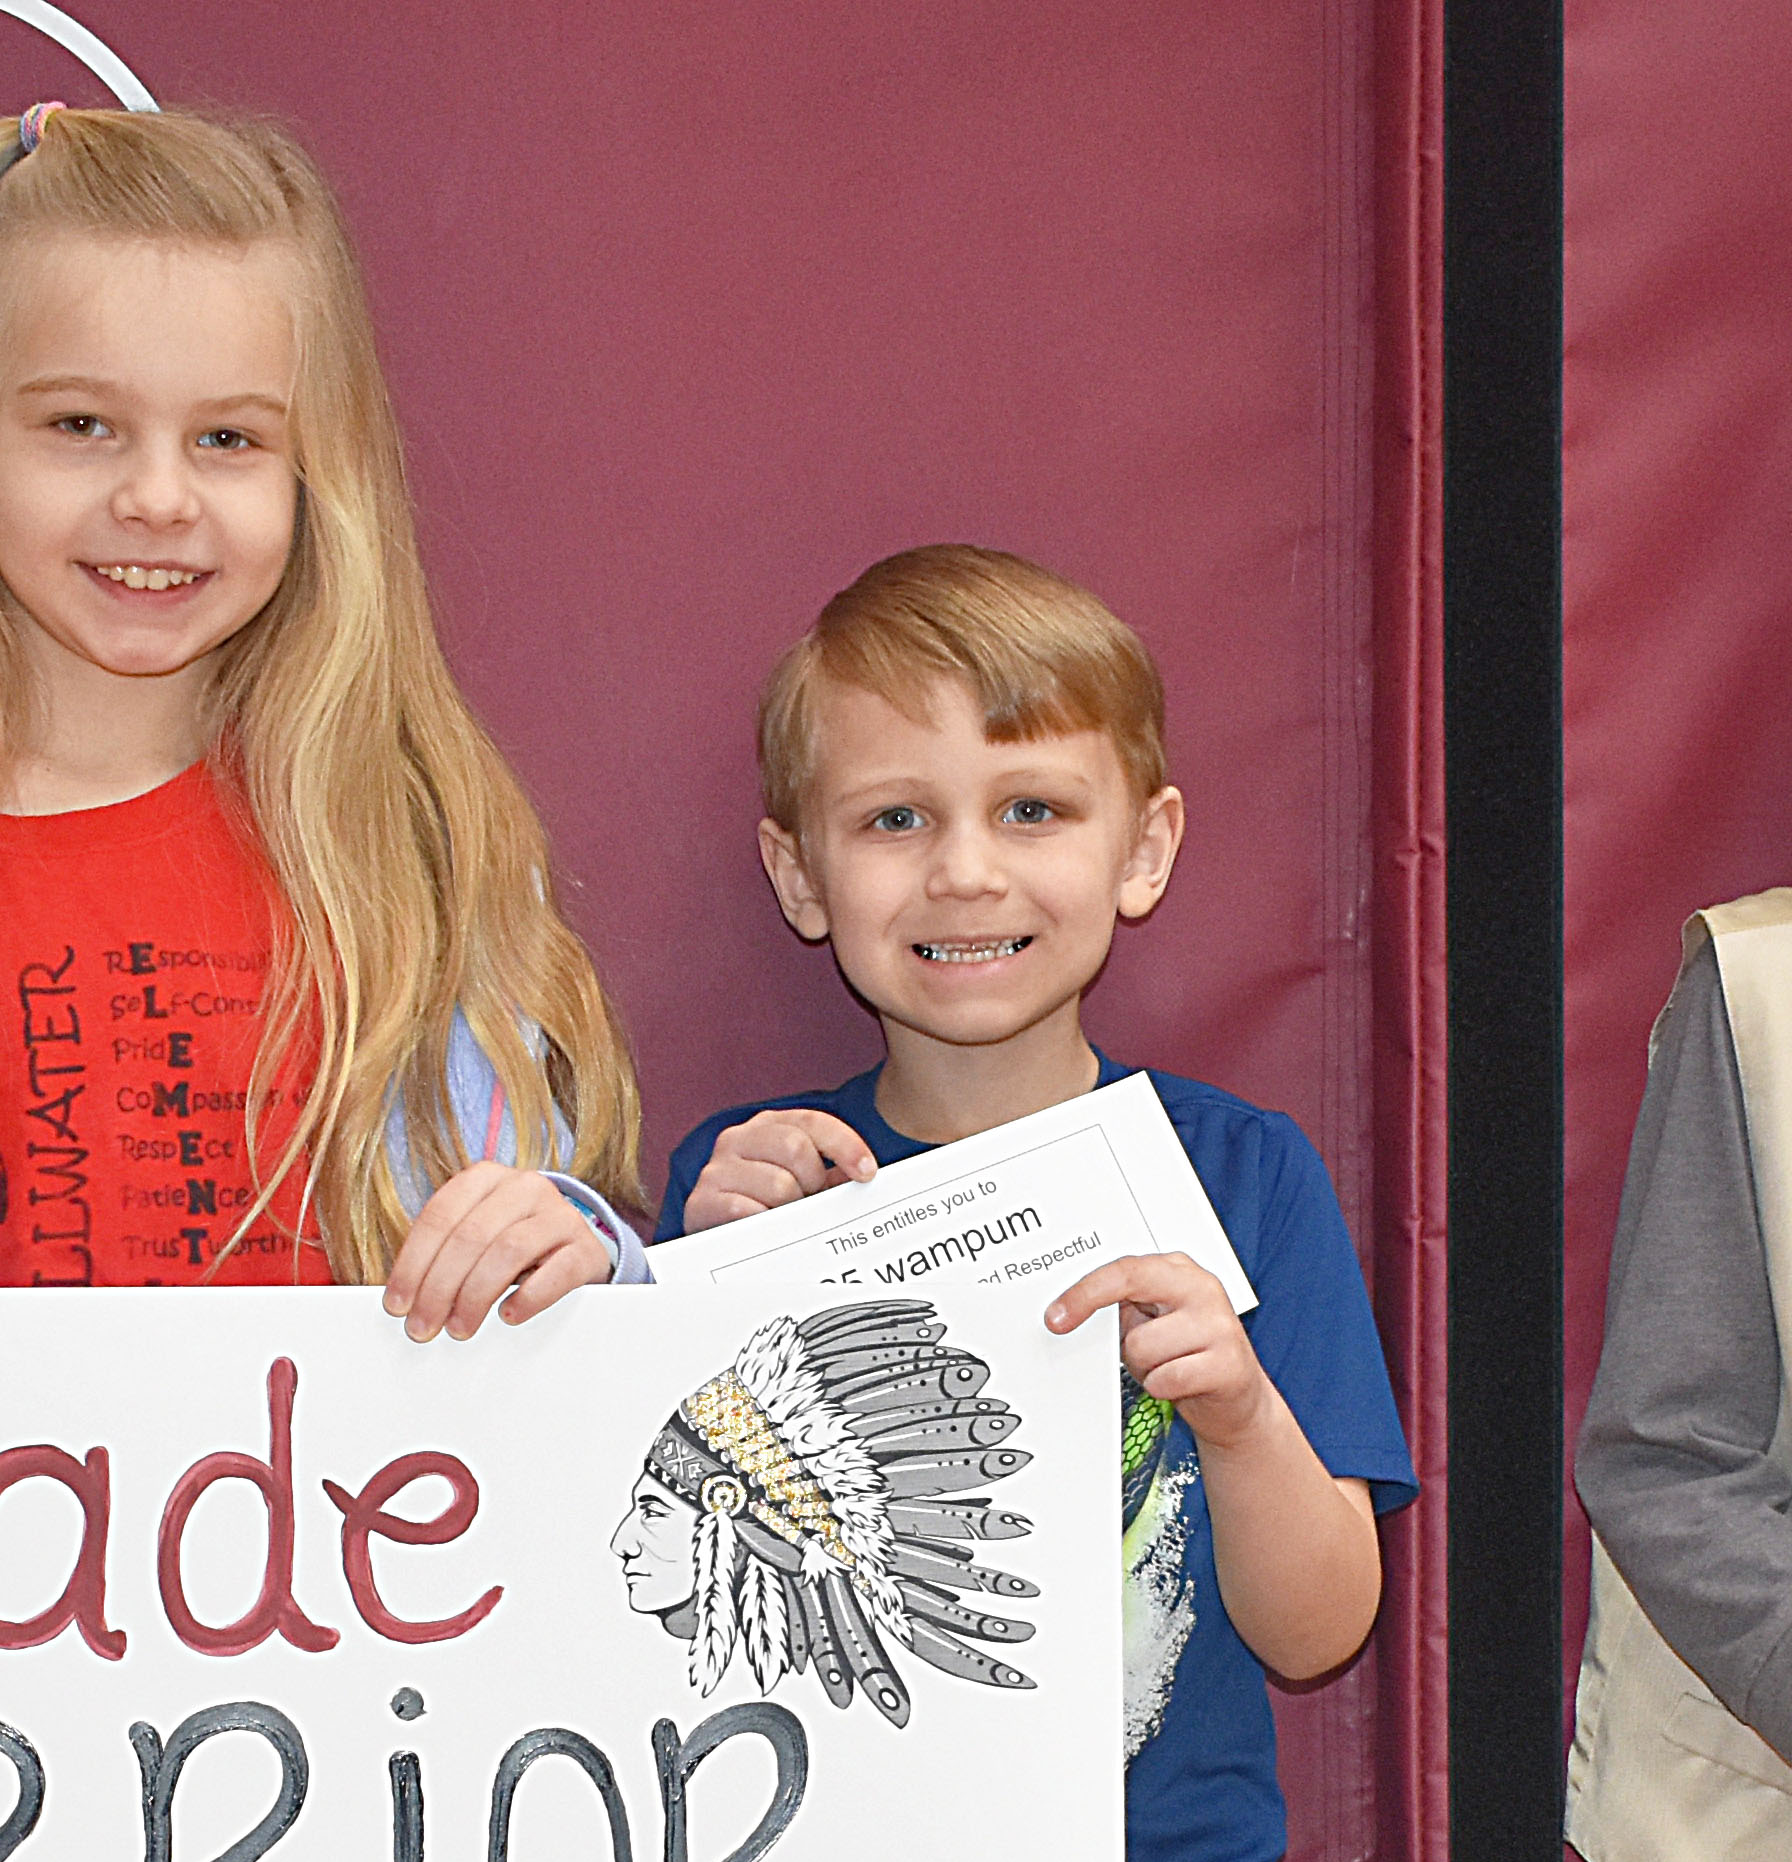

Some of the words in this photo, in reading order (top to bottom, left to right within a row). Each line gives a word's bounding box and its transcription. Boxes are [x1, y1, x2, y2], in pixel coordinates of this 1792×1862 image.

[826, 1230, 868, 1256] This
[872, 1202, 938, 1239] entitles
[940, 1189, 976, 1215] you
[979, 1180, 998, 1196] to
[873, 1206, 1043, 1285] wampum
[1003, 1231, 1103, 1281] Respectful
